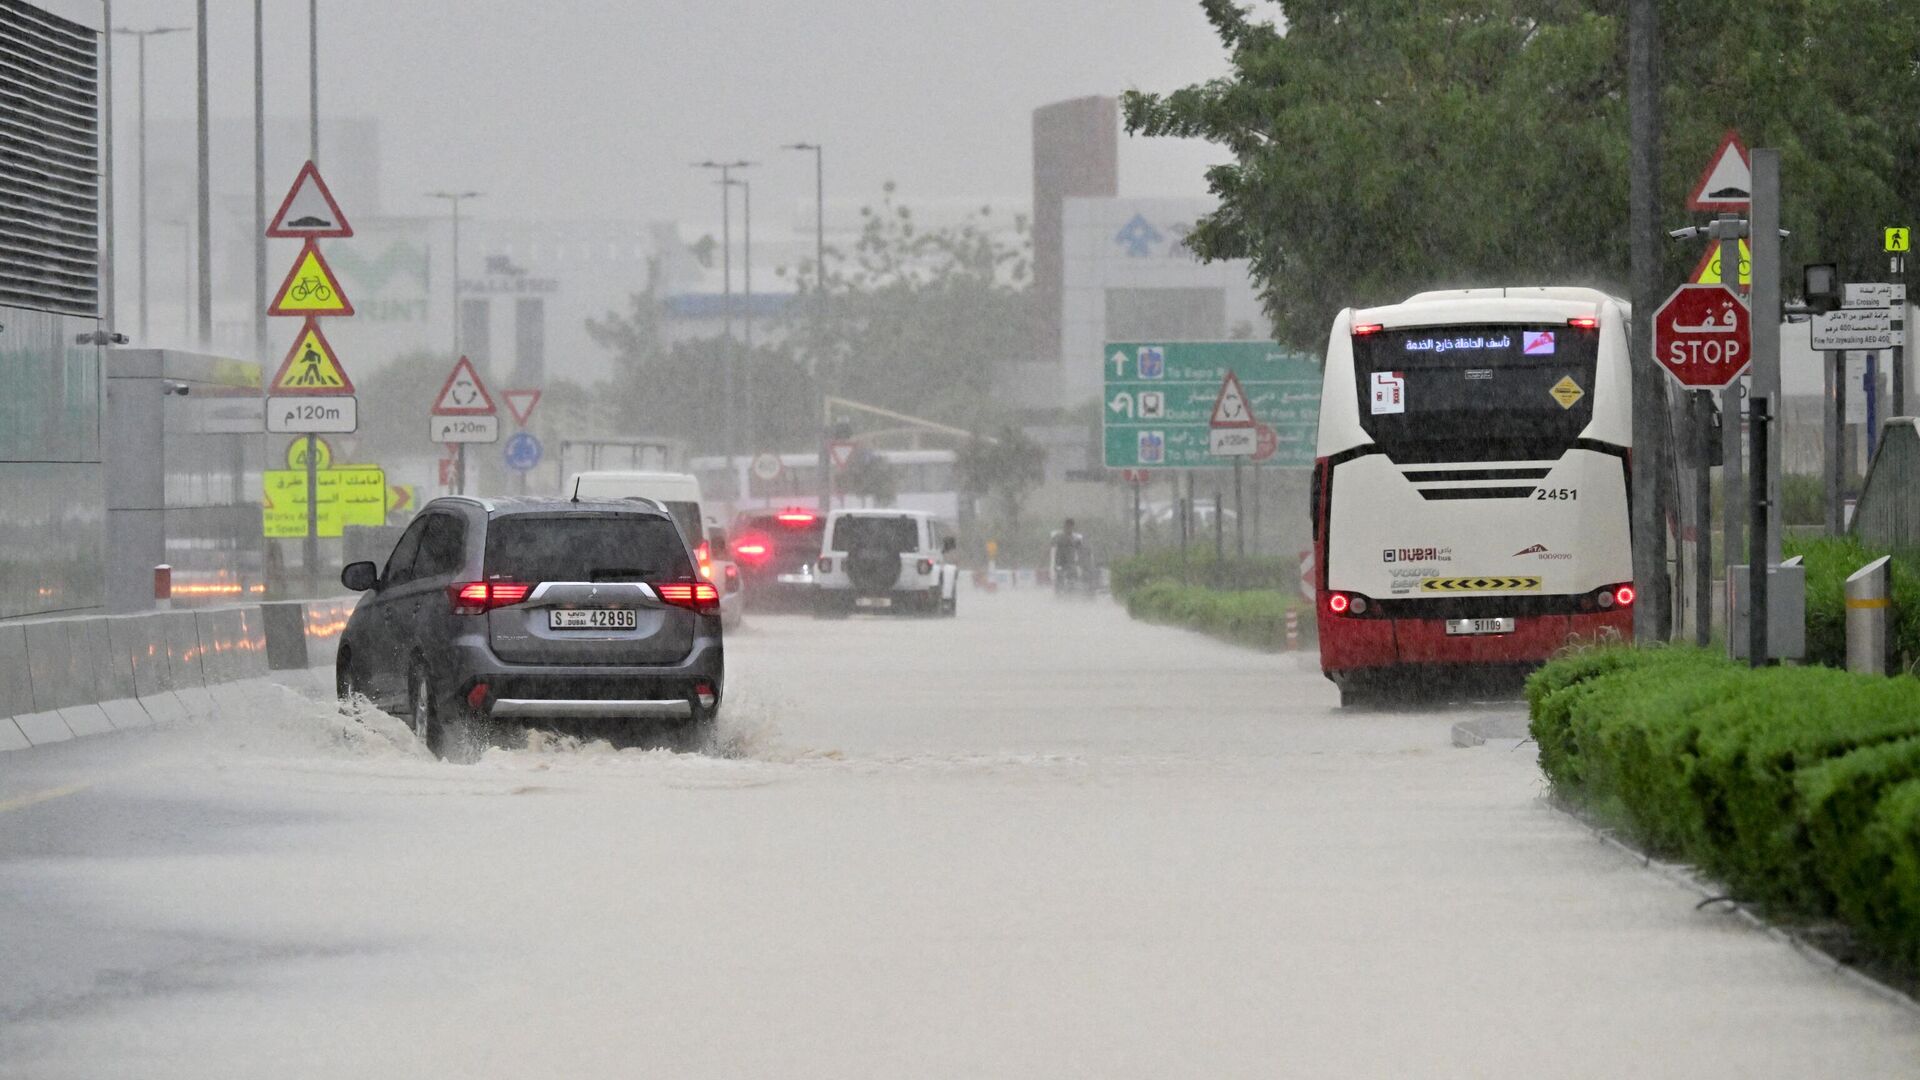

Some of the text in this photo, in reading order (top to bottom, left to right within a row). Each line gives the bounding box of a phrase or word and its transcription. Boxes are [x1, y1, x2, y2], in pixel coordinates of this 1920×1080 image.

[1856, 298, 1880, 306] Crossing
[1672, 301, 1738, 333] قف
[1865, 335, 1877, 343] AED
[1670, 340, 1739, 364] STOP
[1537, 488, 1578, 501] 2451
[1398, 548, 1437, 562] DUBAI
[555, 611, 562, 626] S
[590, 611, 634, 626] 42896
[1474, 620, 1501, 631] 51109
